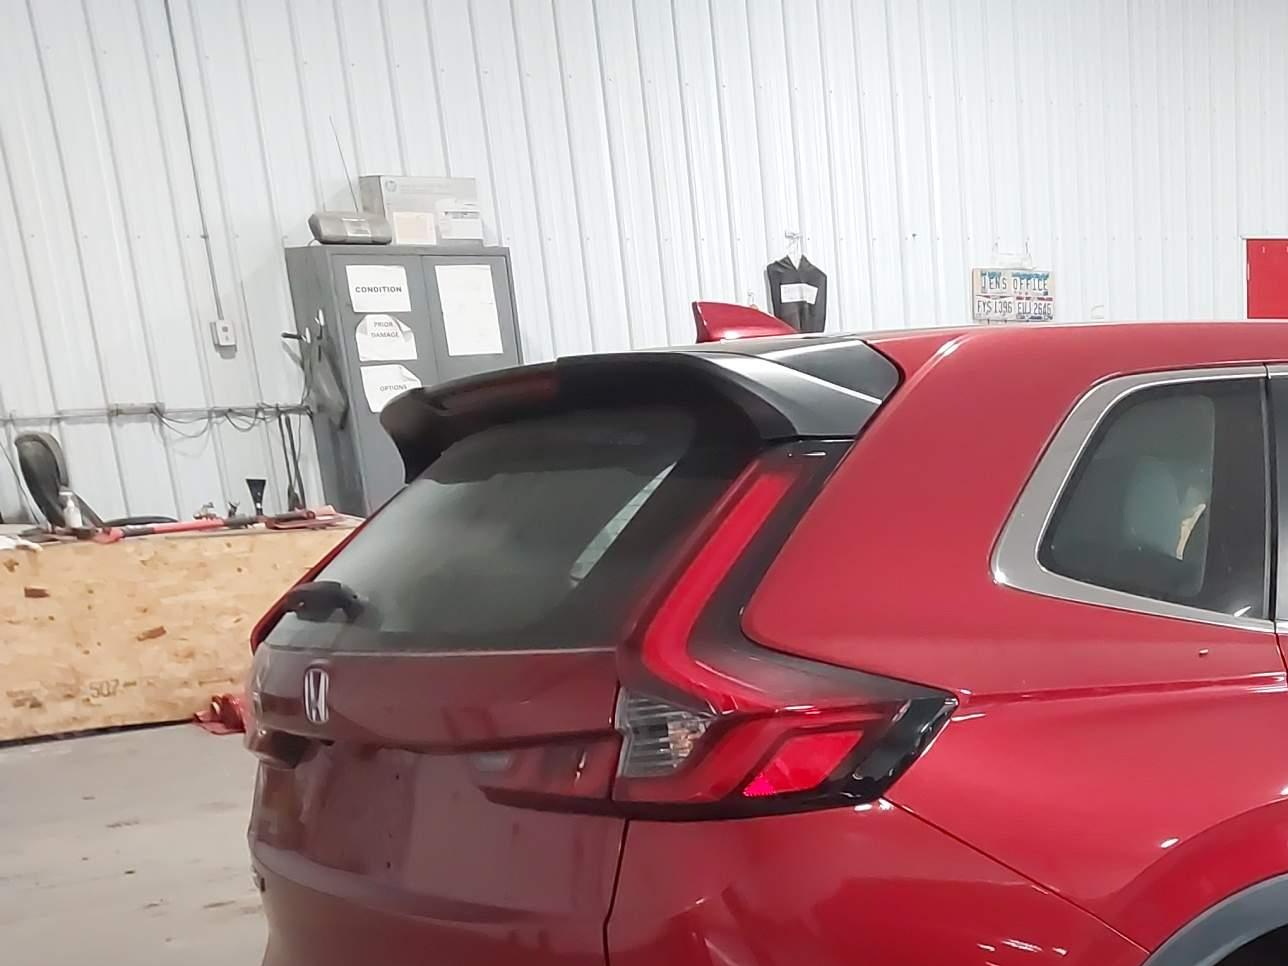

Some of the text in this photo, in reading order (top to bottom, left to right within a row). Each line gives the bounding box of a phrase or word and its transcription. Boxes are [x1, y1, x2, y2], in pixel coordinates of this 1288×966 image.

[981, 276, 1049, 291] JENS OFFICE
[355, 286, 402, 294] CONDITION
[379, 384, 408, 392] OPTIONS
